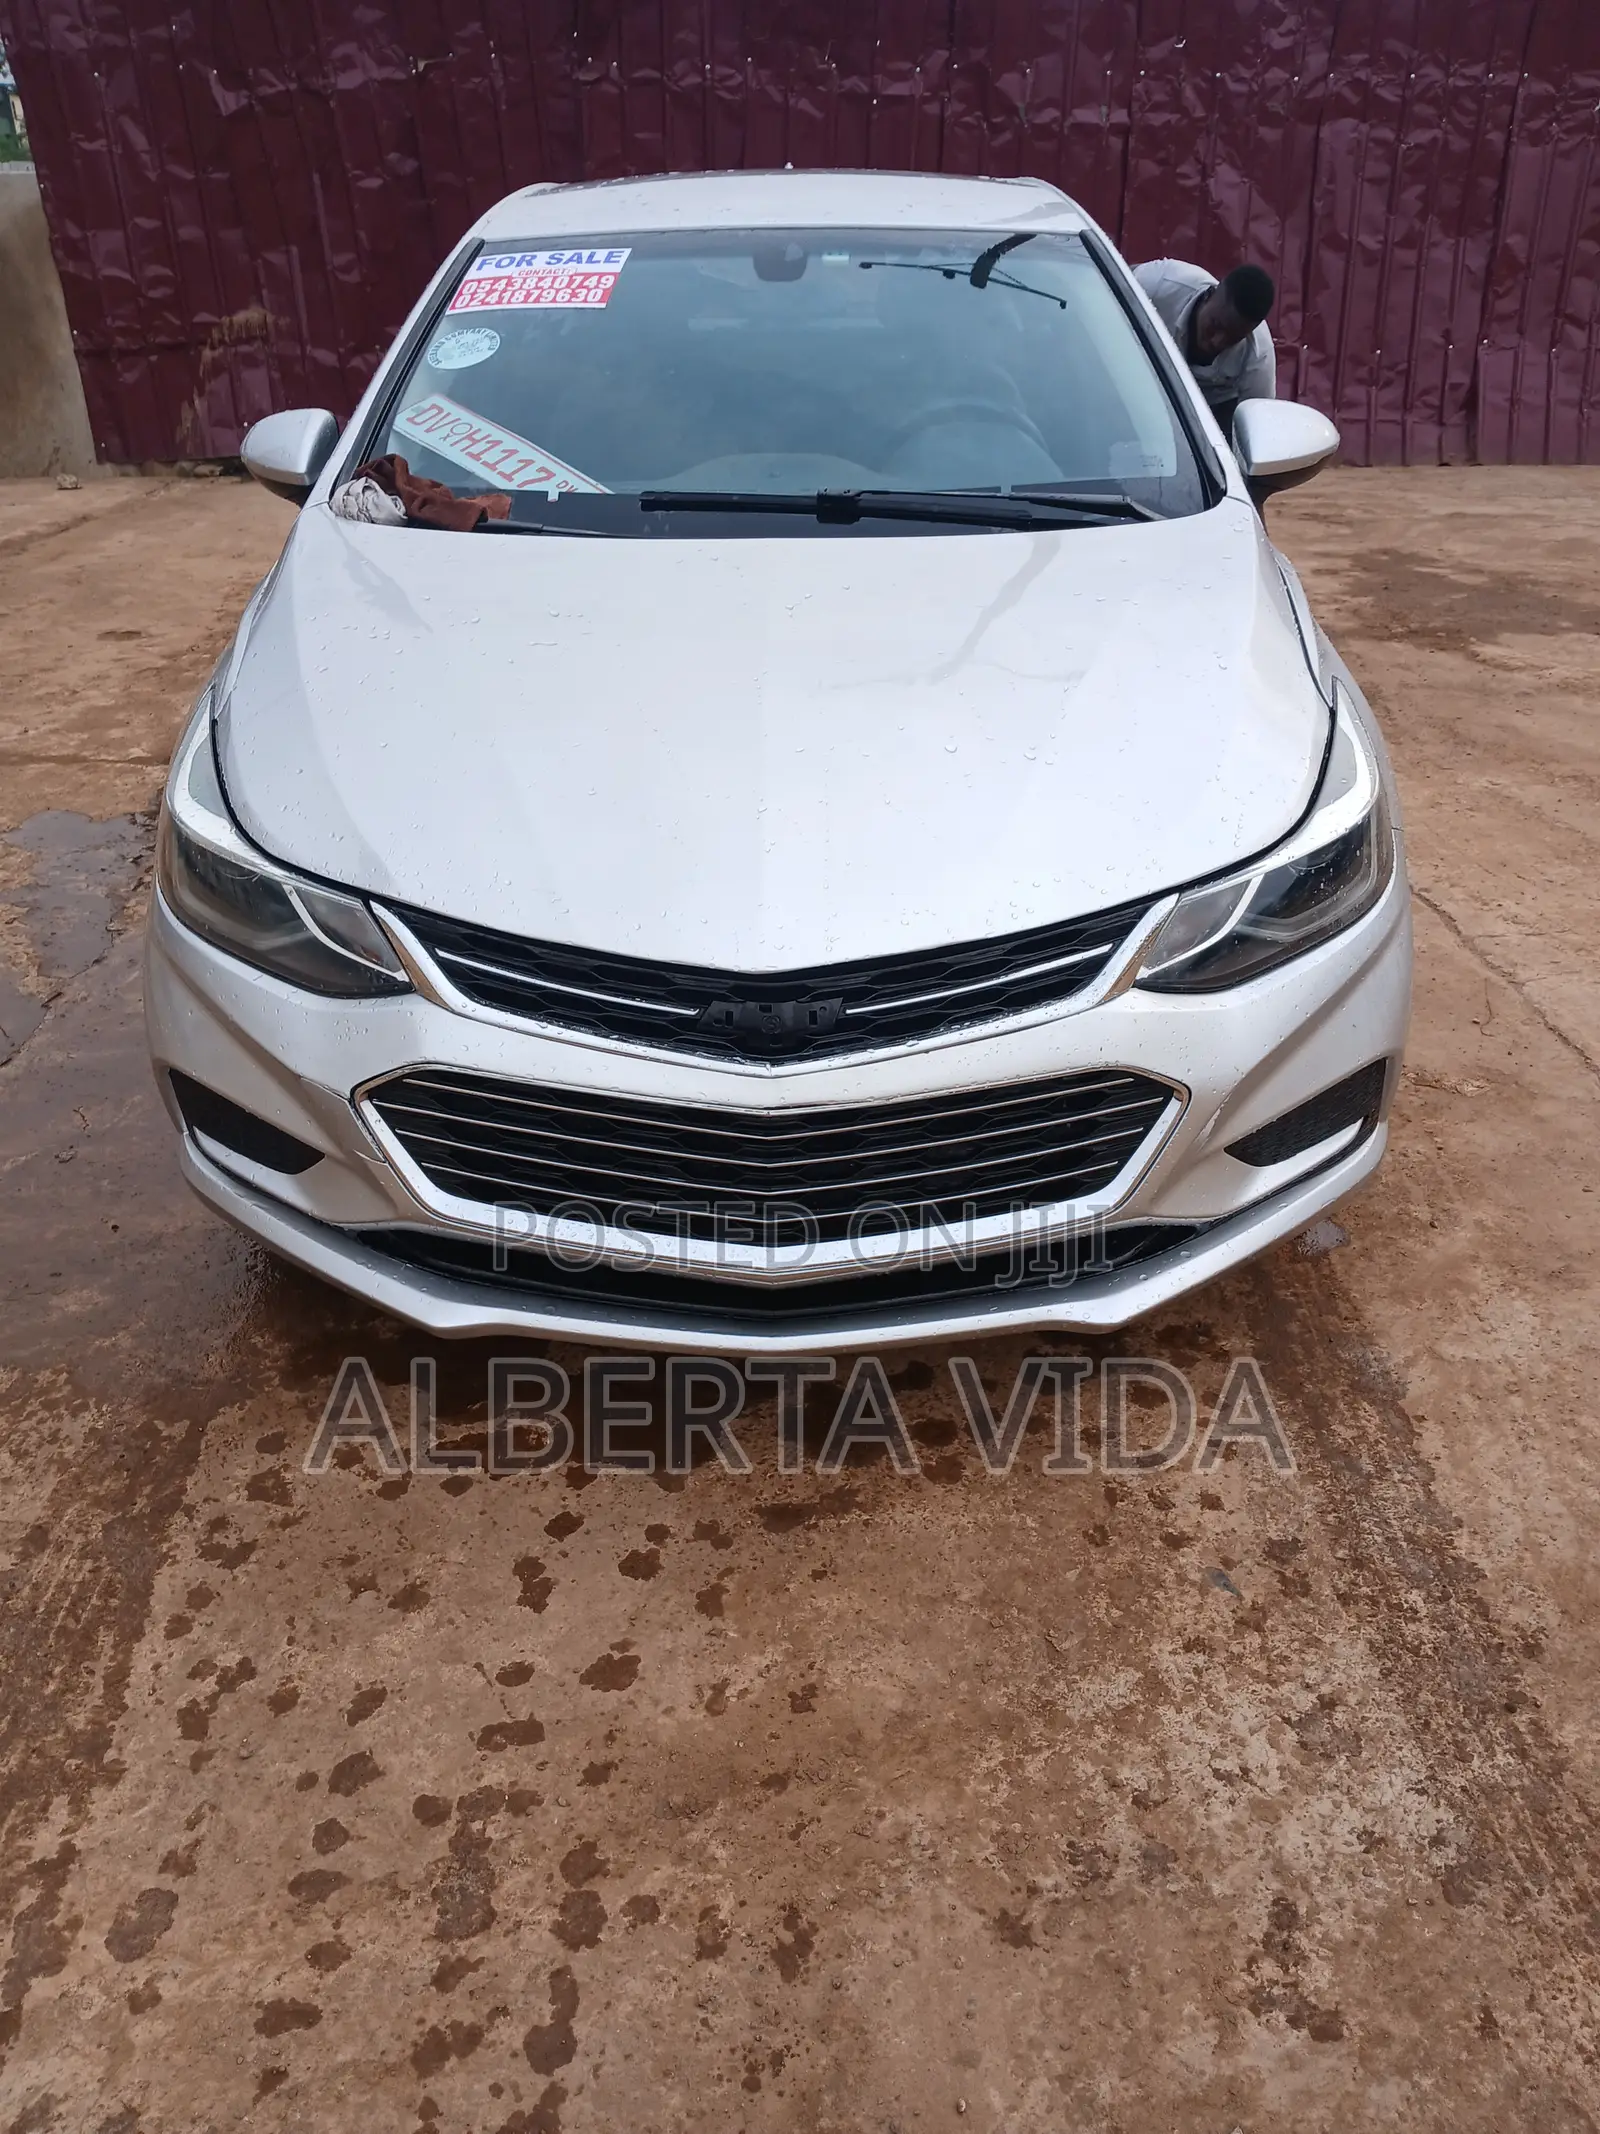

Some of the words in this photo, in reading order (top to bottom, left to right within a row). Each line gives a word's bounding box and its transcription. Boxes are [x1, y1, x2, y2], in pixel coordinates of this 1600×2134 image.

[475, 254, 537, 272] FOR
[545, 250, 625, 266] SALE
[462, 275, 615, 294] 0543840749
[455, 288, 603, 309] 0241879630
